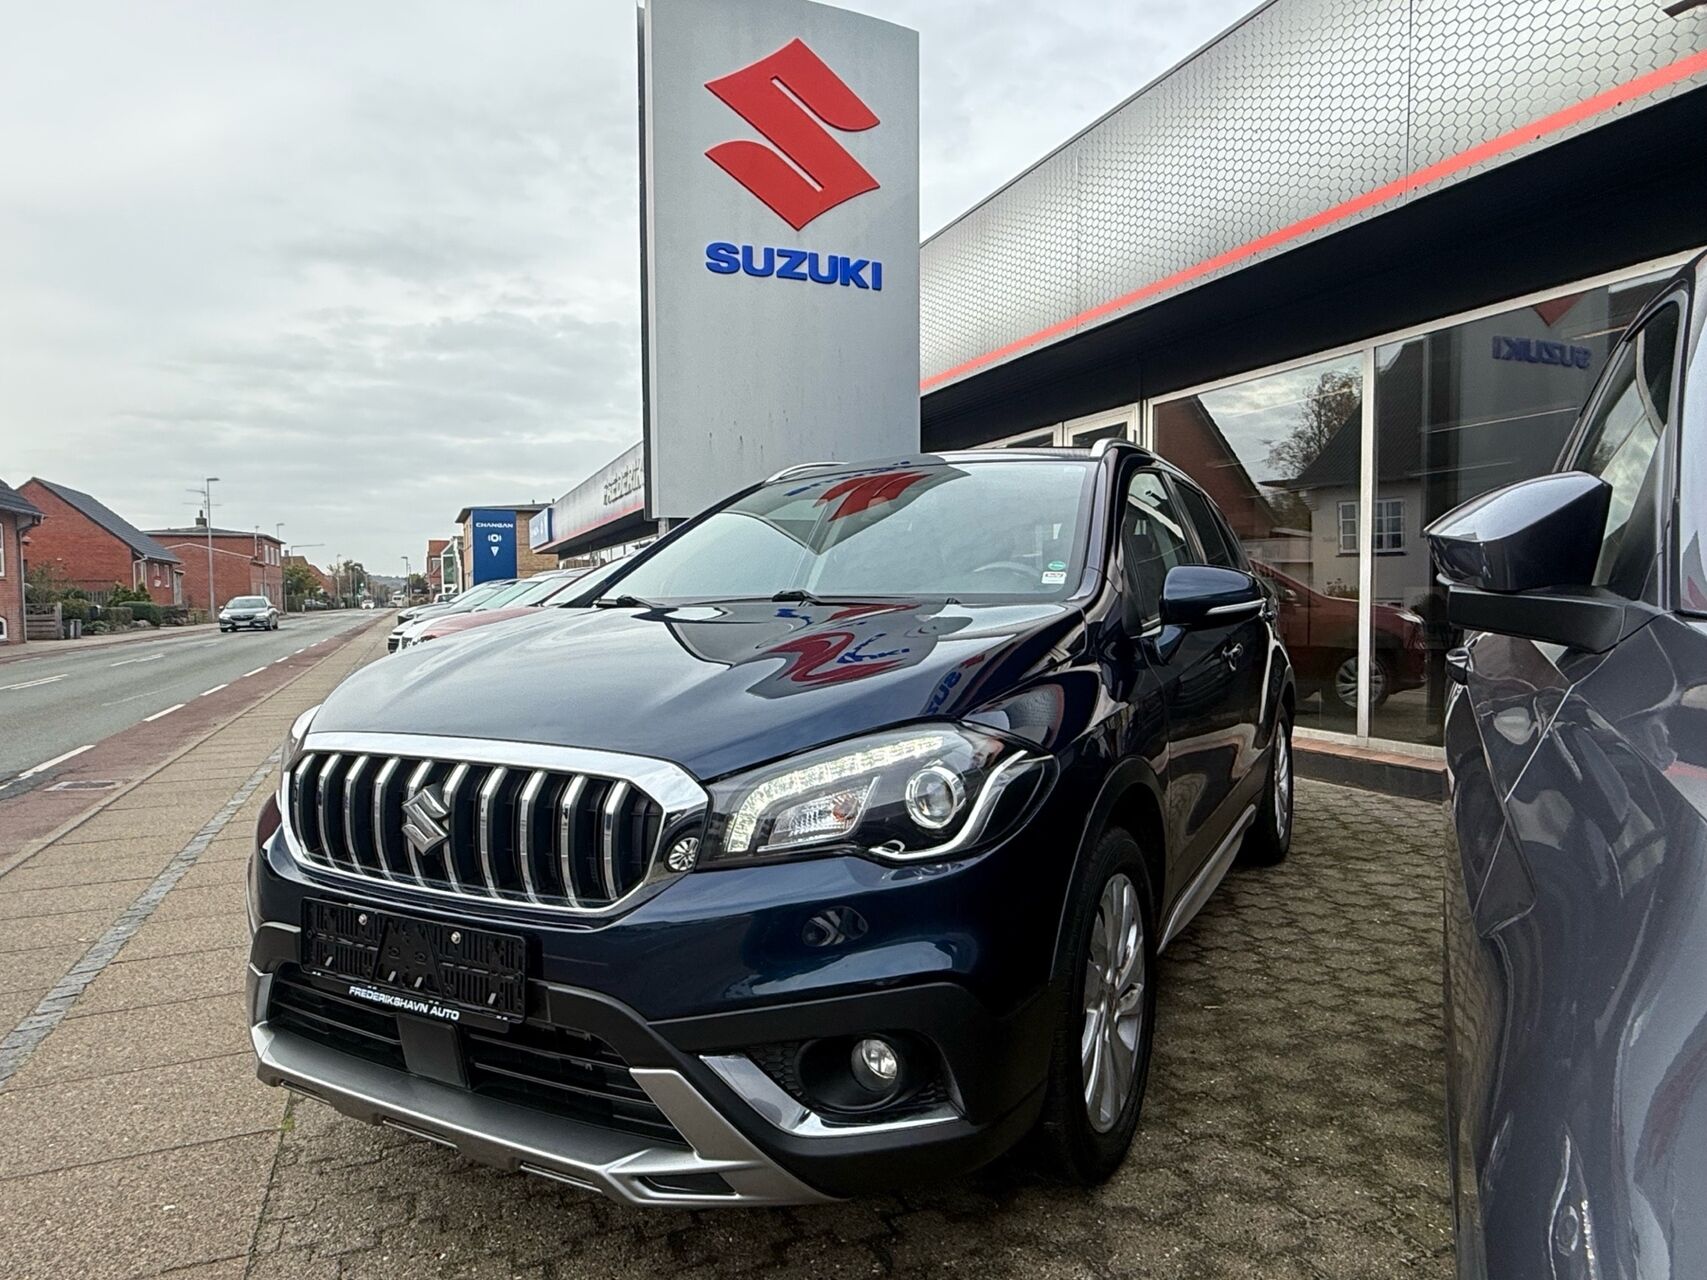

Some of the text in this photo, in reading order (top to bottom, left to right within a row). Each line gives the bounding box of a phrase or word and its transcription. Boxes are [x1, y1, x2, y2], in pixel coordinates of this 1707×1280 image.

[705, 242, 883, 291] SUZUKI
[603, 459, 644, 506] FREDERIK
[348, 985, 460, 1021] FREDERIKSHAVN AUTO
